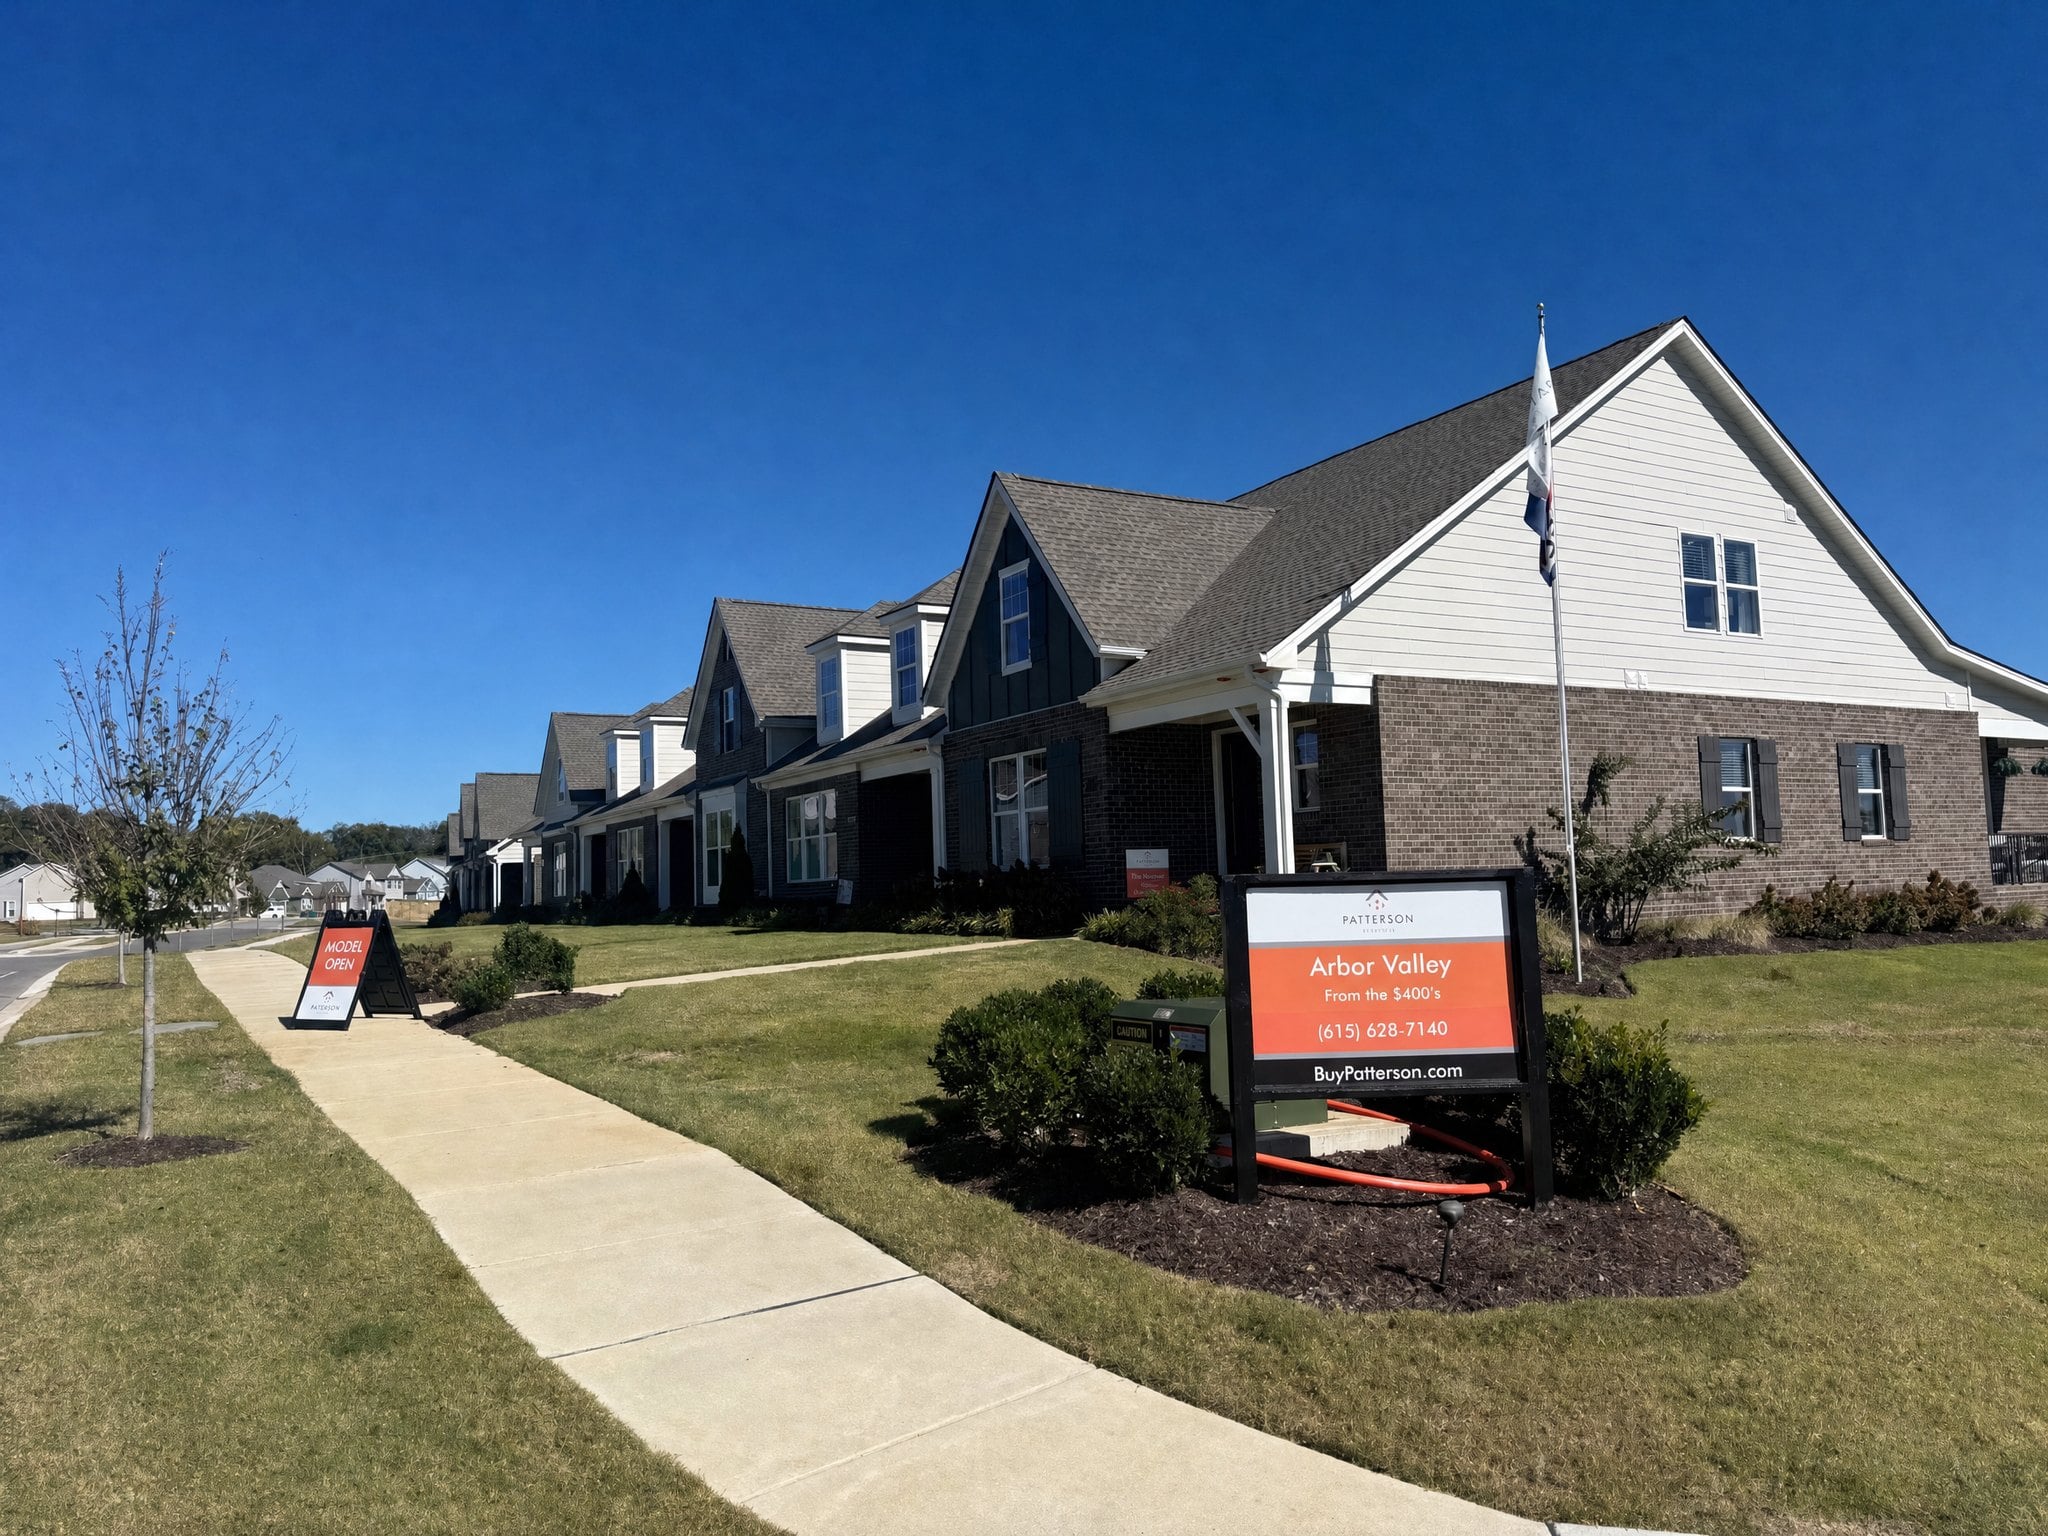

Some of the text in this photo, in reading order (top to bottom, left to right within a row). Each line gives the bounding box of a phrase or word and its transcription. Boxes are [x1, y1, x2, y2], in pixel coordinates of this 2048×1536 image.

[1342, 914, 1414, 925] PATTERSON
[324, 940, 363, 953] MODEL
[324, 957, 355, 970] OPEN
[1309, 952, 1452, 979] Arbor Valley
[1324, 986, 1441, 1003] From the $400's
[1116, 1026, 1148, 1039] CAUTION
[1317, 1020, 1448, 1043] (615) 628-7140
[1313, 1064, 1463, 1085] BuyPatterson.com
